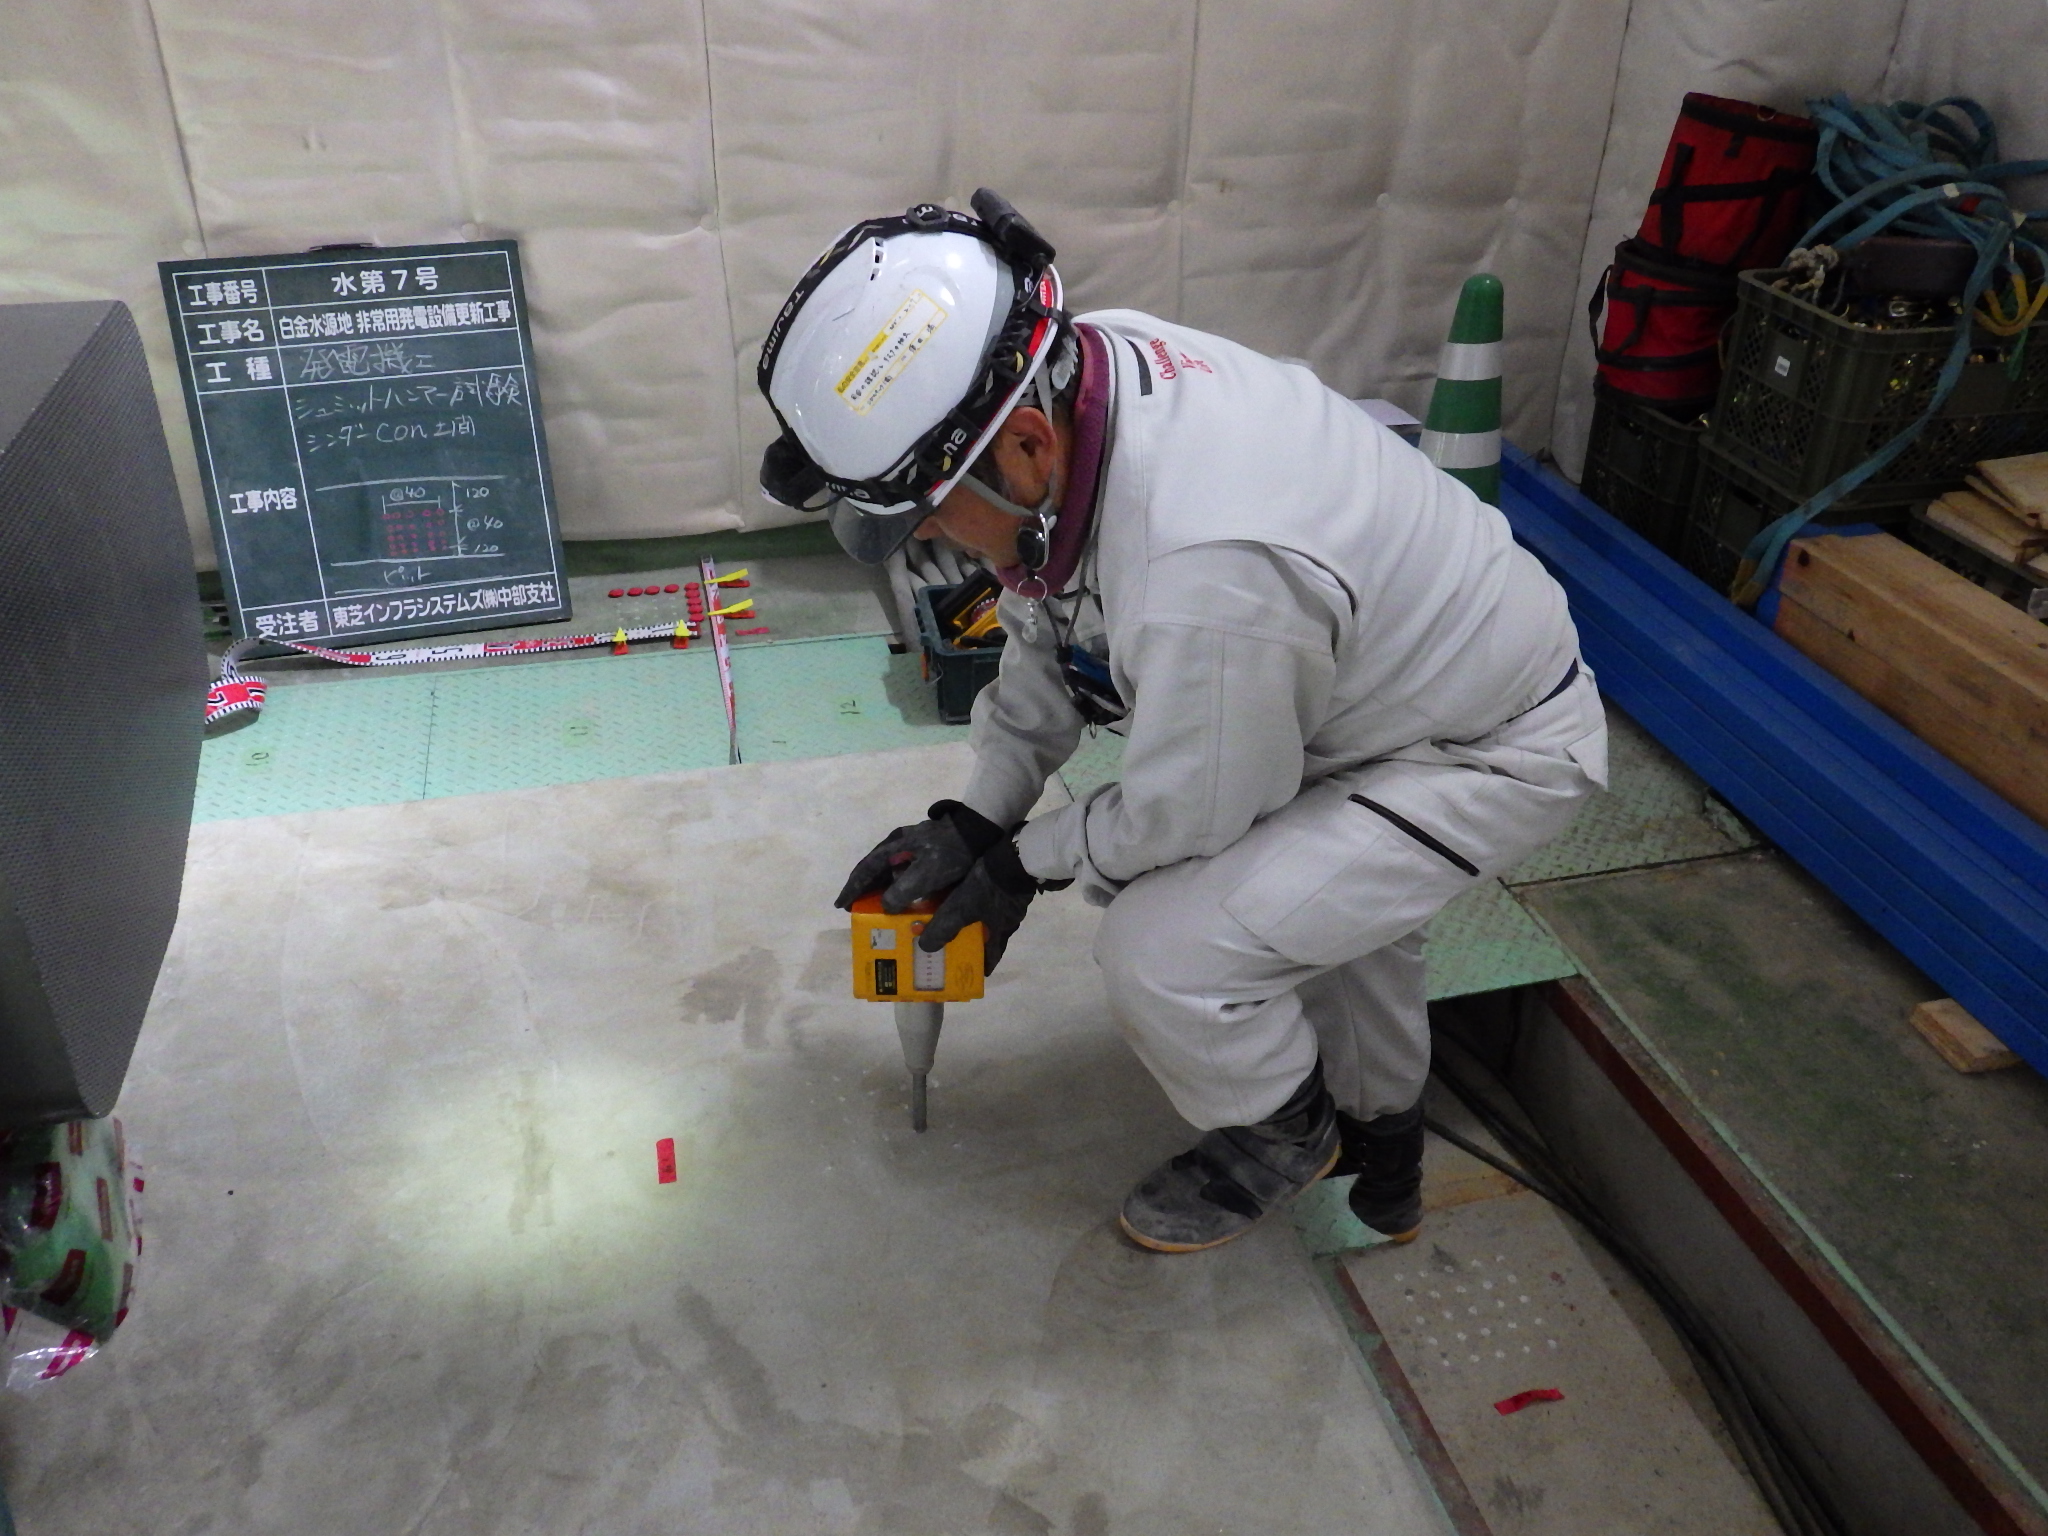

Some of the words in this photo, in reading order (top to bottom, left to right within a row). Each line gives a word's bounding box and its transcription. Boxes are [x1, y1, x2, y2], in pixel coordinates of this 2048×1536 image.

[187, 279, 258, 306] 工事番号
[331, 266, 439, 297] 水第7号
[198, 318, 265, 345] 工事名
[279, 311, 354, 340] 白金水源地
[356, 300, 511, 333] 非常用発電設備更新工事
[229, 487, 298, 514] 工事内容
[466, 486, 490, 499] 120
[255, 609, 319, 639] 受注者
